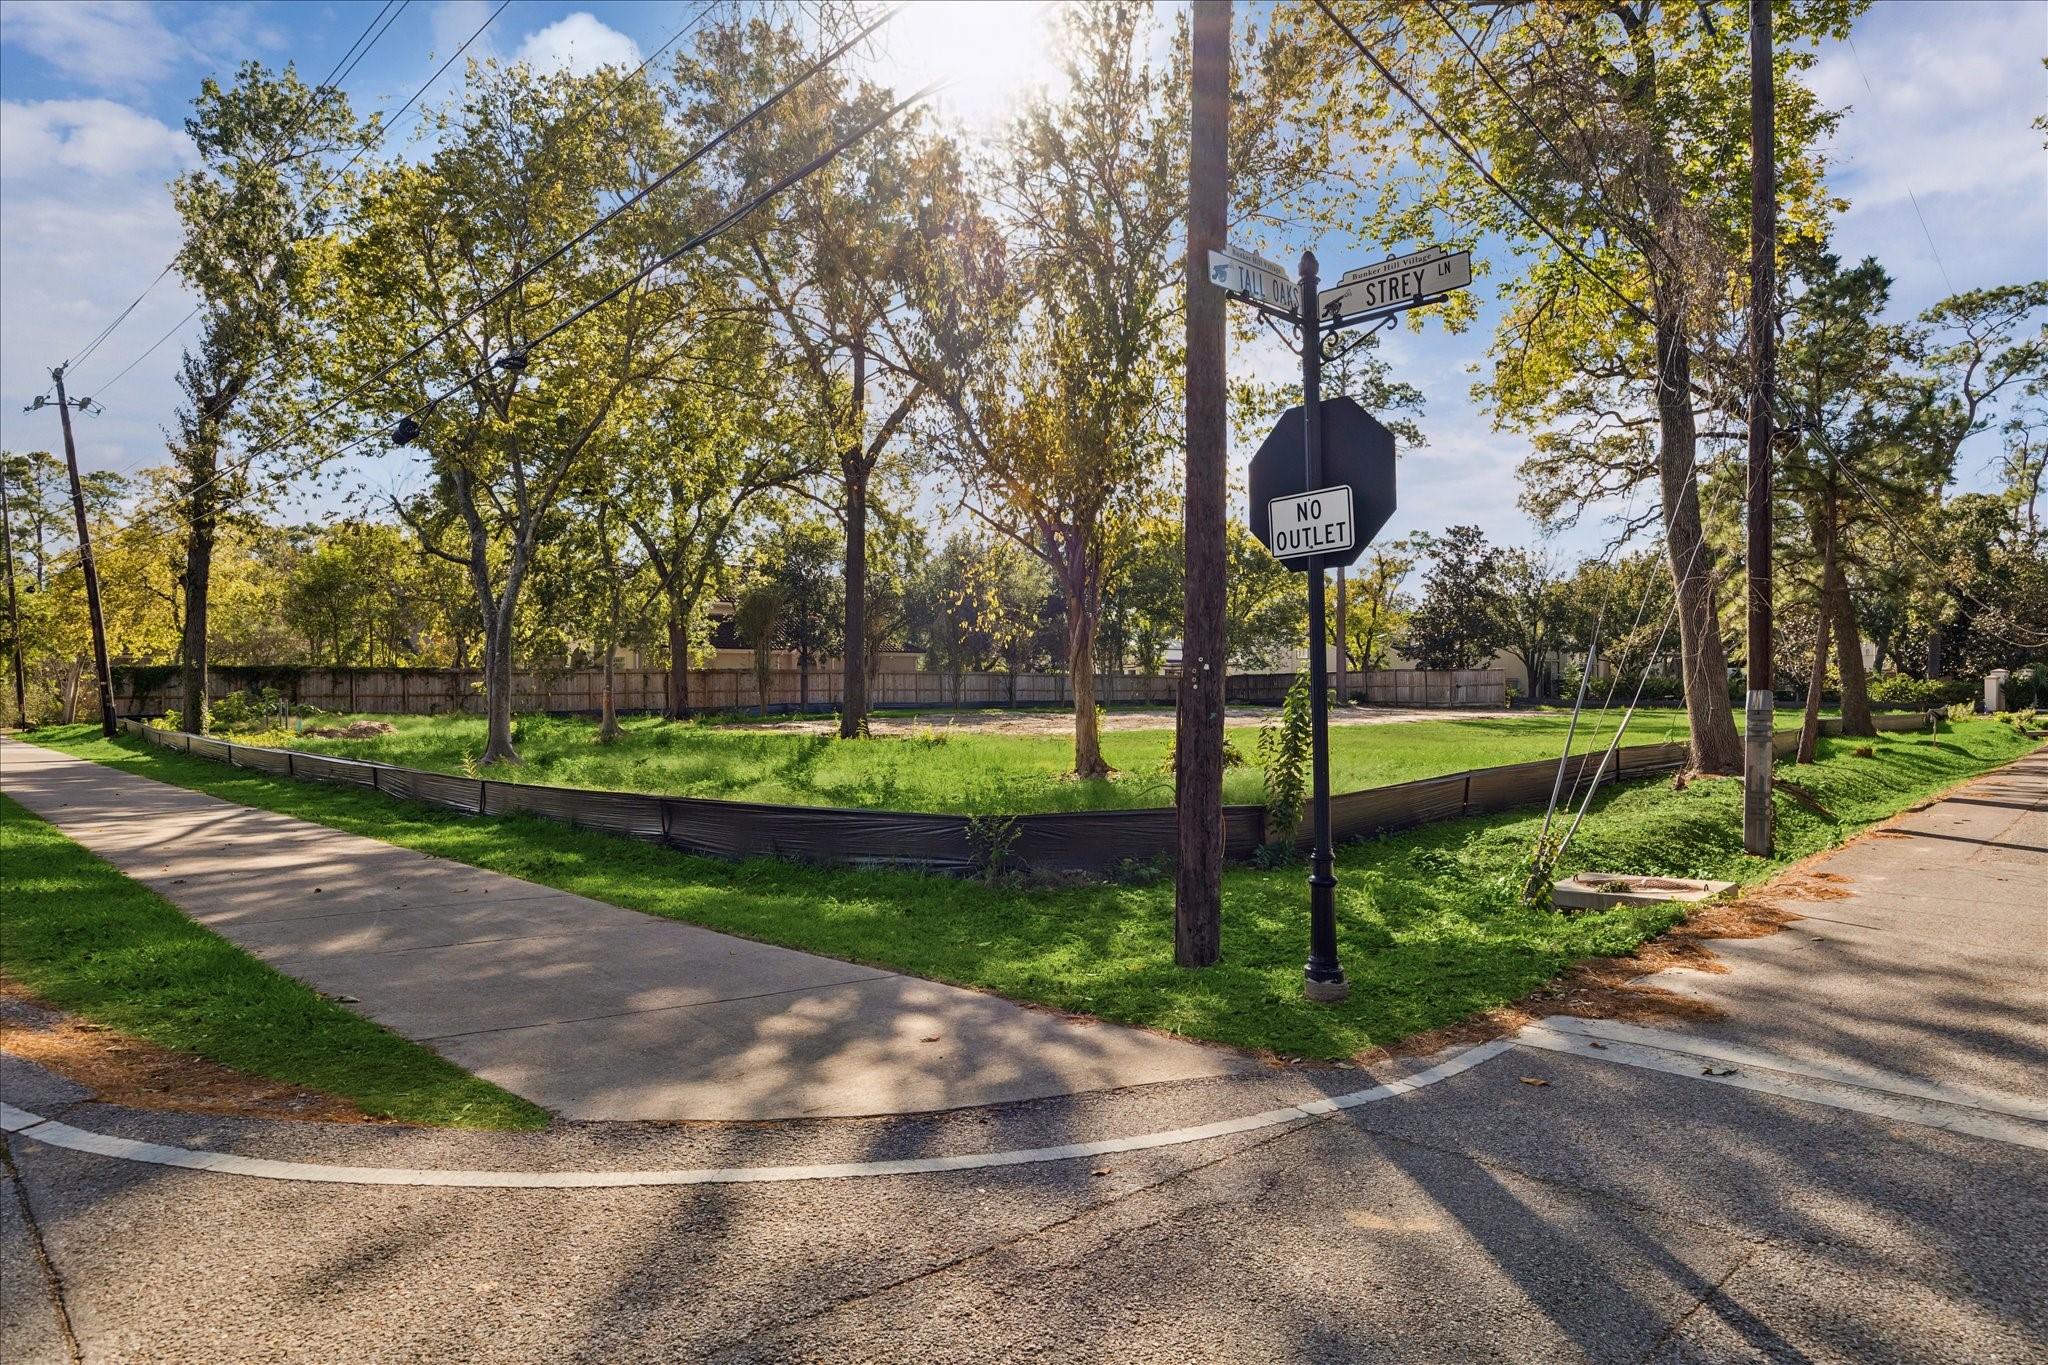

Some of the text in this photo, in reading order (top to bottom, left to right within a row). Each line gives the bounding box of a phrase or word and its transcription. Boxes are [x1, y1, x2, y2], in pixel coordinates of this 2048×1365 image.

[1352, 254, 1432, 280] Bunker Hill Village
[1238, 266, 1300, 308] TALL OAKS
[1366, 260, 1451, 307] STREY LN
[1297, 499, 1321, 522] NO
[1276, 521, 1346, 551] OUTLET
